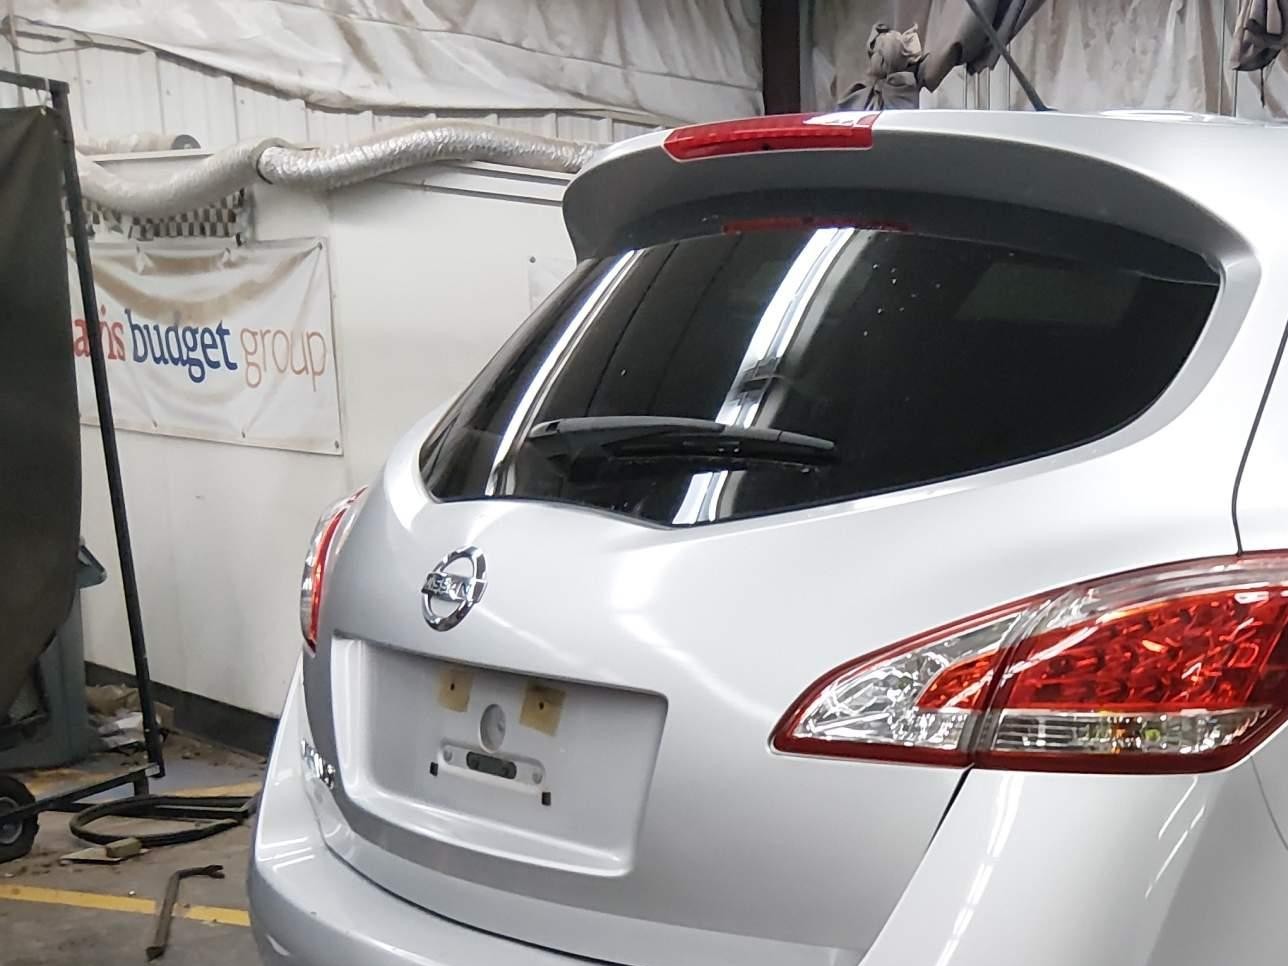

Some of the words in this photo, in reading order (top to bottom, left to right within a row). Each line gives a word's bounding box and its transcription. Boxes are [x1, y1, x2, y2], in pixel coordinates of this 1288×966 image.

[72, 303, 127, 363] ais
[125, 307, 239, 384] budget
[239, 326, 327, 392] group
